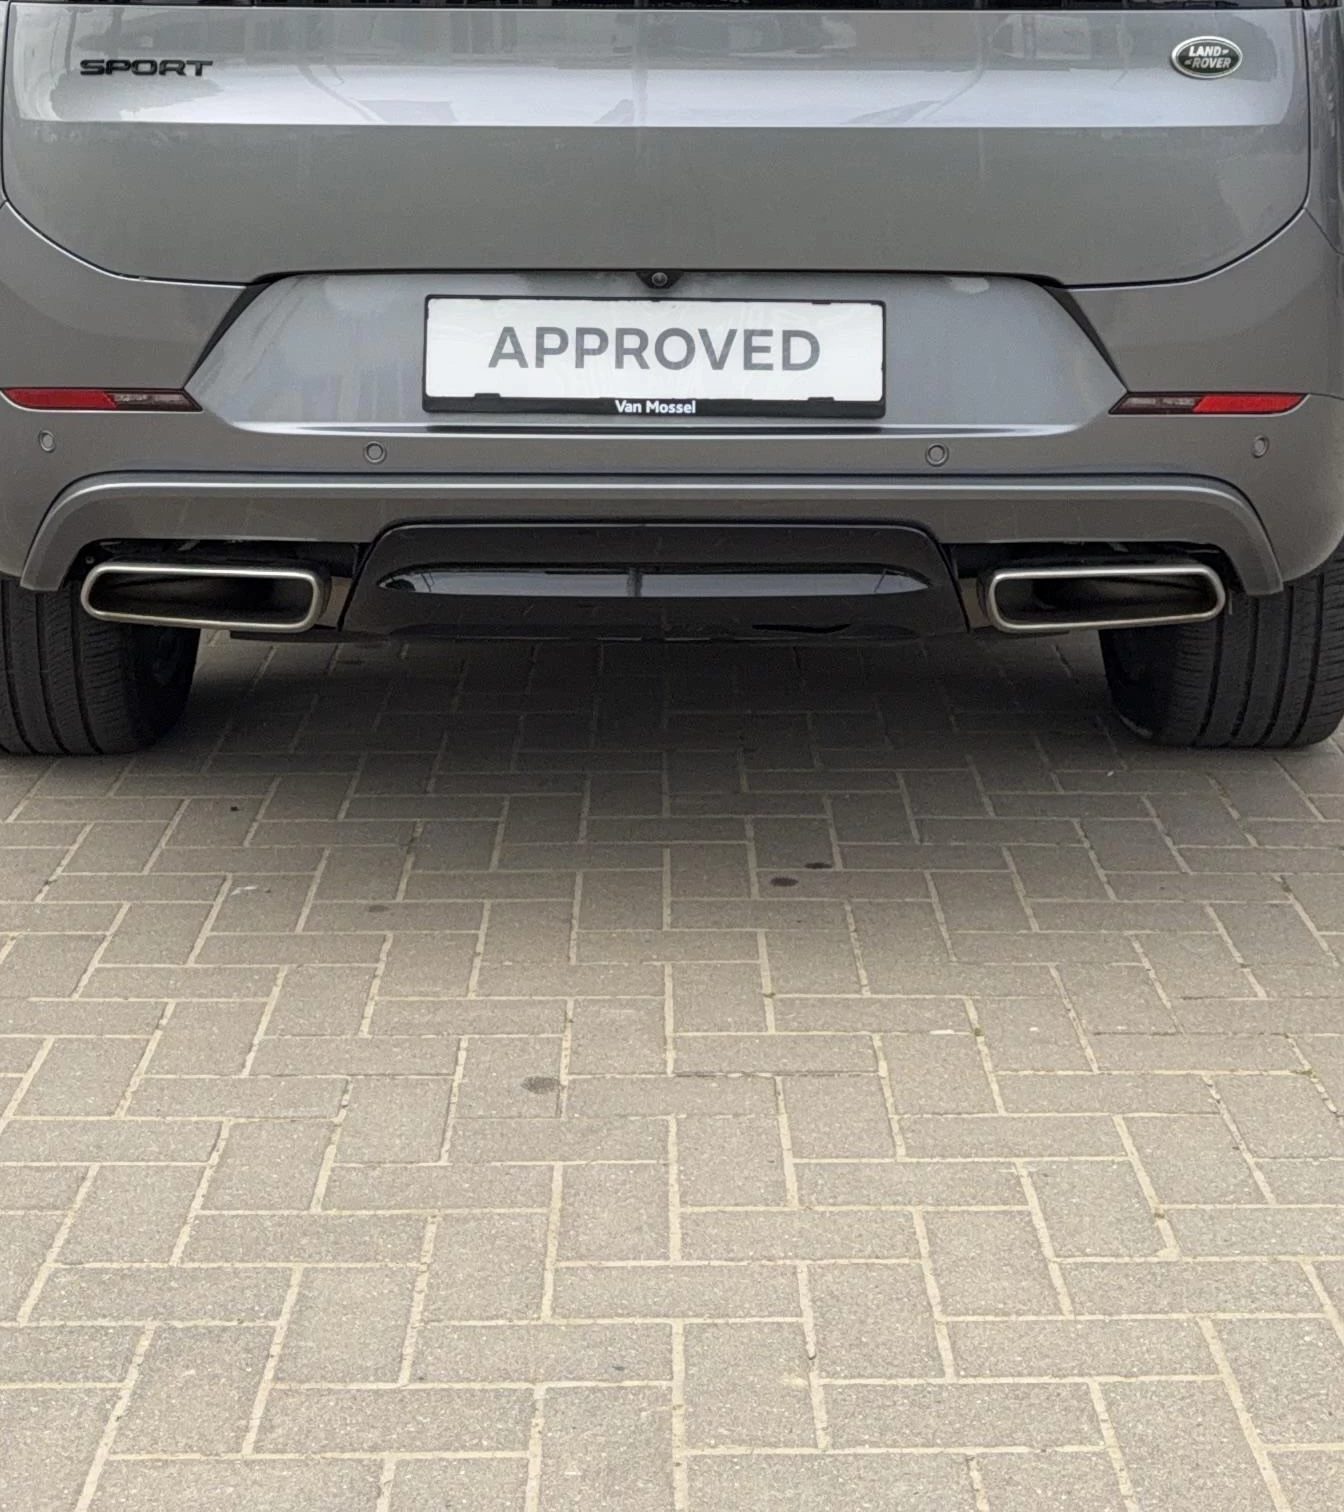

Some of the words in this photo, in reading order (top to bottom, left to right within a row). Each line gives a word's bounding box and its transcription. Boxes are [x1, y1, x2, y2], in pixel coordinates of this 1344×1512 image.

[1188, 45, 1222, 57] LAND
[79, 59, 214, 77] SPORT
[1191, 57, 1232, 69] ROVER
[488, 325, 821, 372] APPROVED
[614, 399, 642, 414] Van
[645, 399, 697, 414] Mossel
